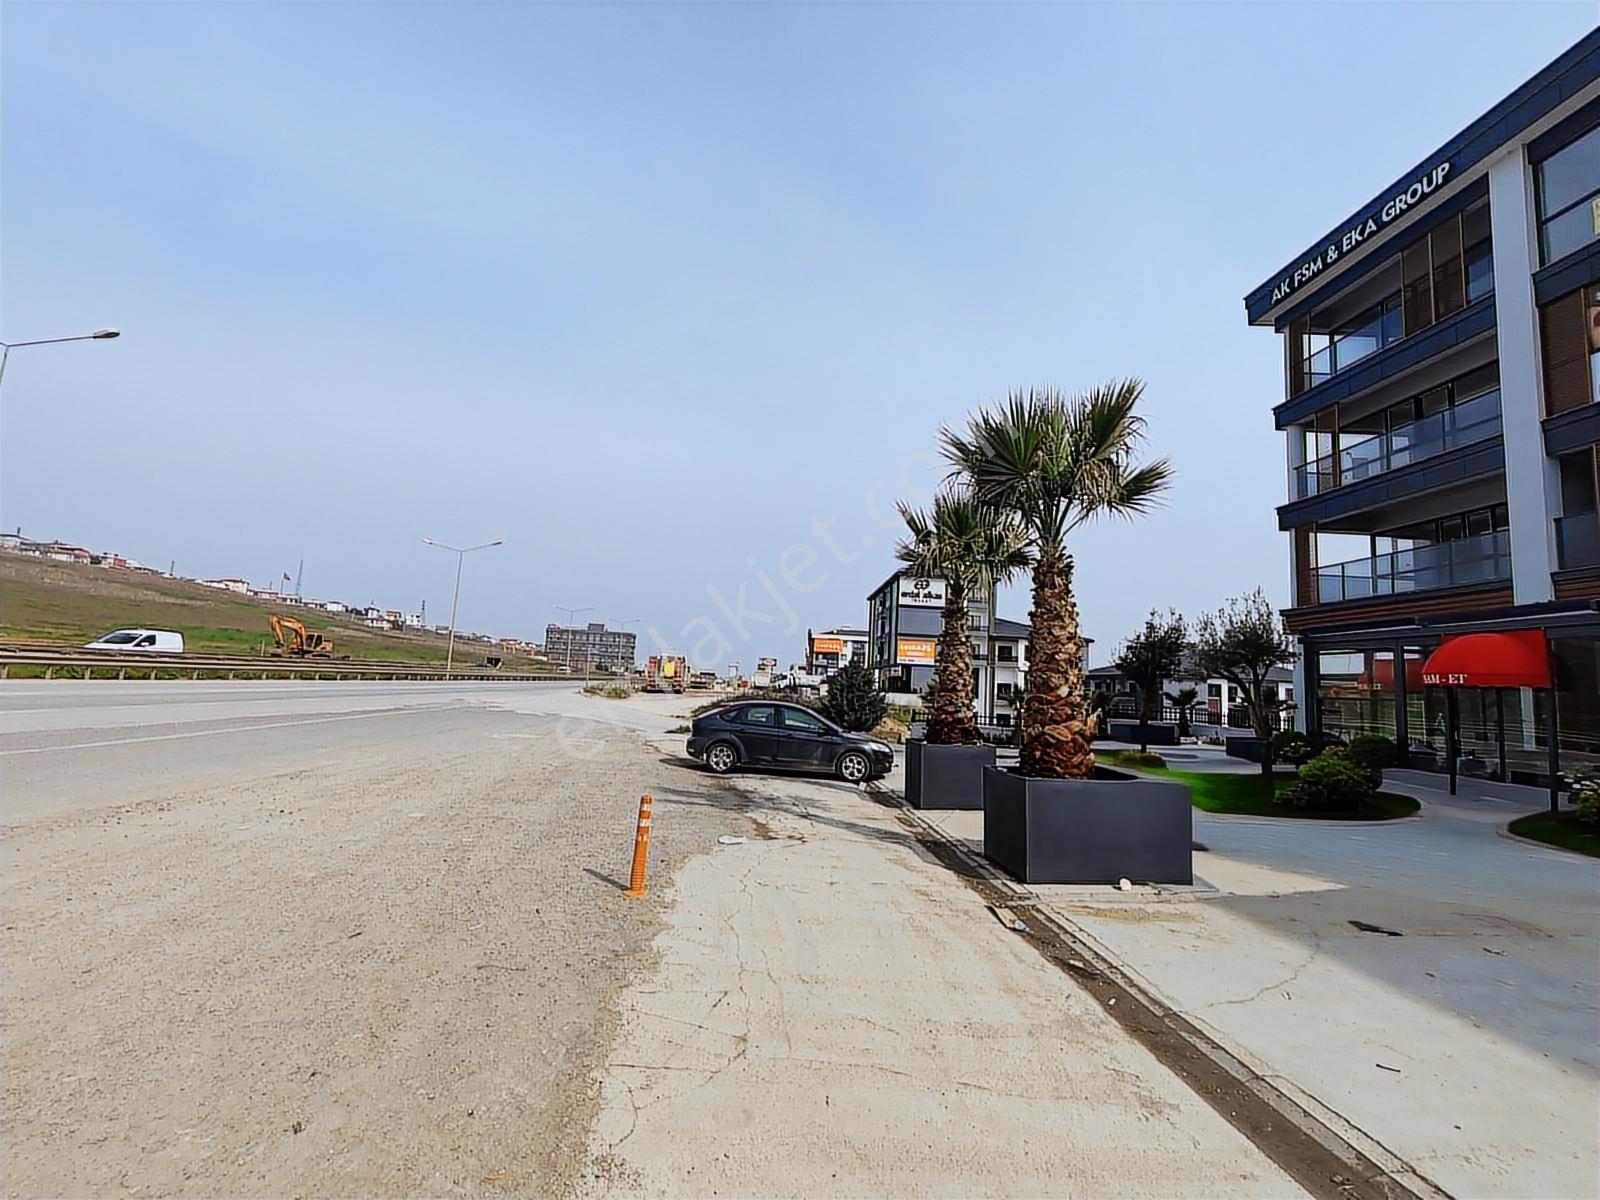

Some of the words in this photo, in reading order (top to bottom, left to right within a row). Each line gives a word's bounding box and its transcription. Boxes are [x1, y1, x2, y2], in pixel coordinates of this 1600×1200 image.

[1272, 279, 1290, 304] AK
[1294, 256, 1323, 287] FSM
[1326, 245, 1338, 263] &
[1343, 218, 1377, 252] EKA
[1382, 162, 1450, 222] GROUP
